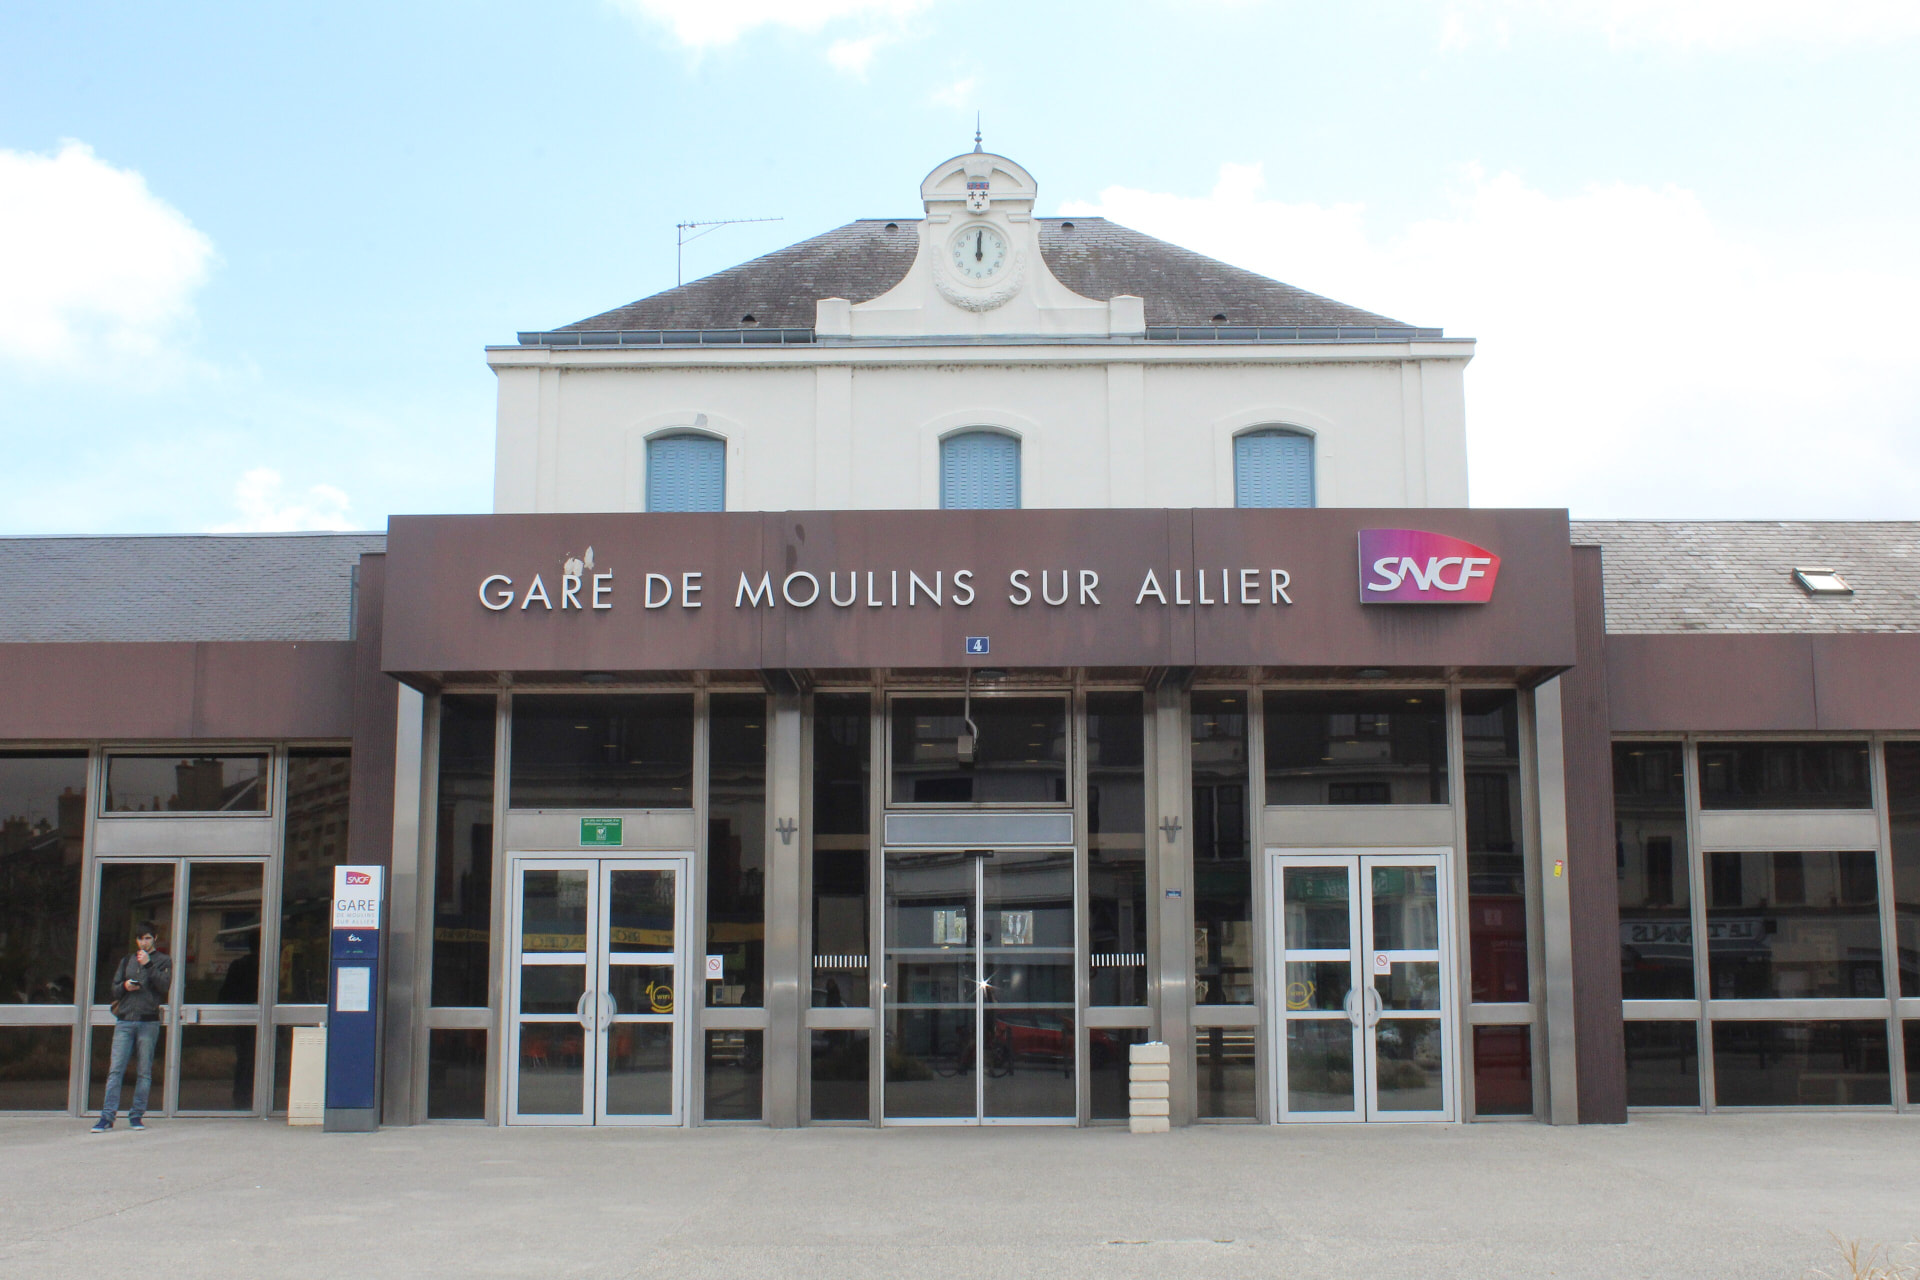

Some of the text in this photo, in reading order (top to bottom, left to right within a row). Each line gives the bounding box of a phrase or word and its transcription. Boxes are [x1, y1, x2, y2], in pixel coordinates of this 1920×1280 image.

[1367, 556, 1491, 592] SNCF
[479, 568, 1293, 611] GARE DE MOULINS SUR ALLIER
[972, 637, 984, 652] 4
[347, 876, 369, 884] SNCF
[337, 899, 376, 911] GARE
